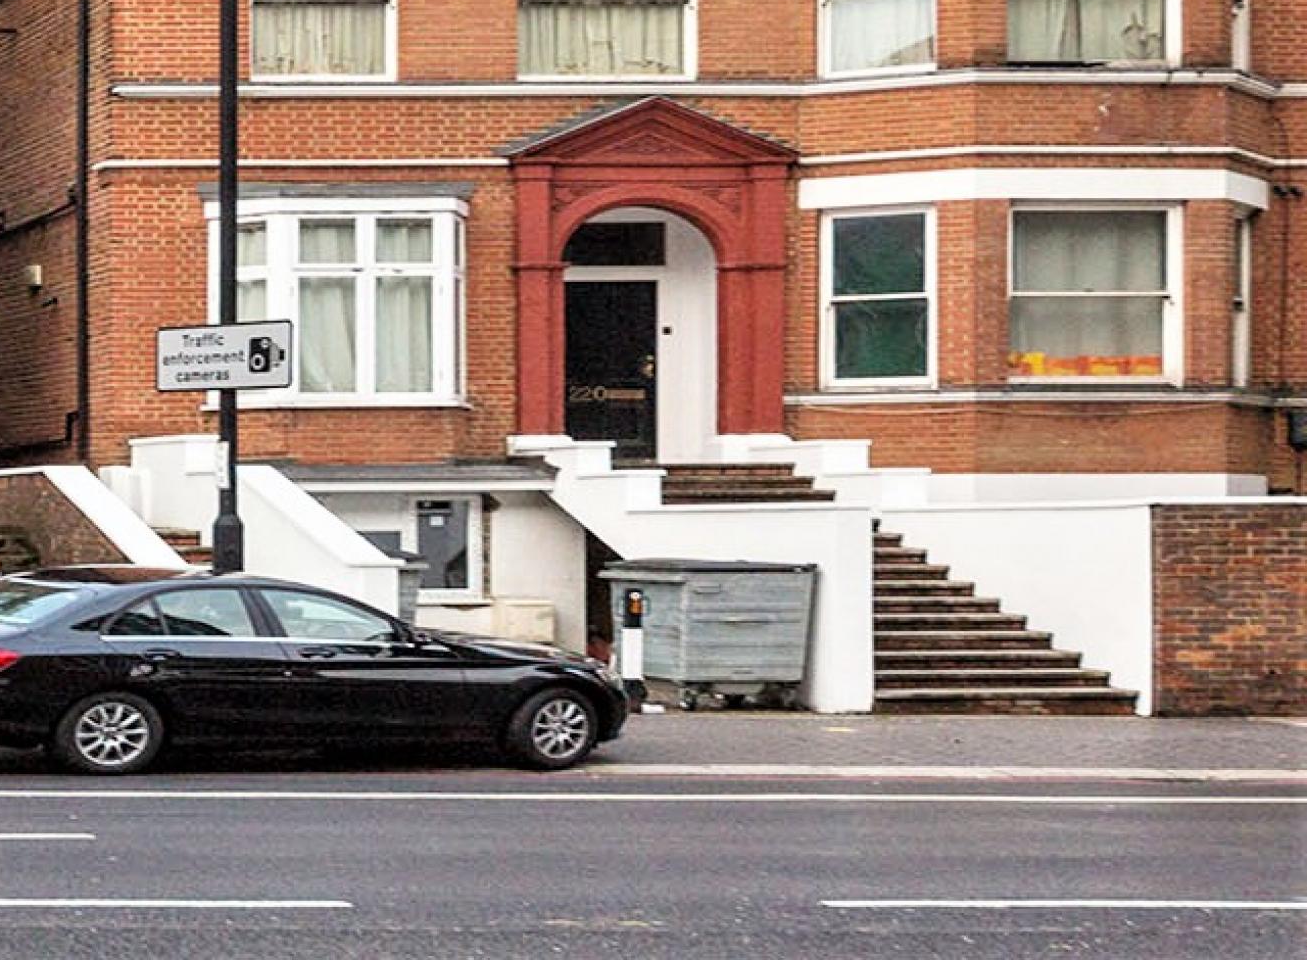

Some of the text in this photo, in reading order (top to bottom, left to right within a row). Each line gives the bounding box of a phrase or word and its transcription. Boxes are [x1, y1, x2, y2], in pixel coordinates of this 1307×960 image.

[182, 333, 225, 348] Traffic
[163, 350, 246, 366] enforcement
[175, 370, 230, 383] cameras
[569, 385, 606, 401] 220
